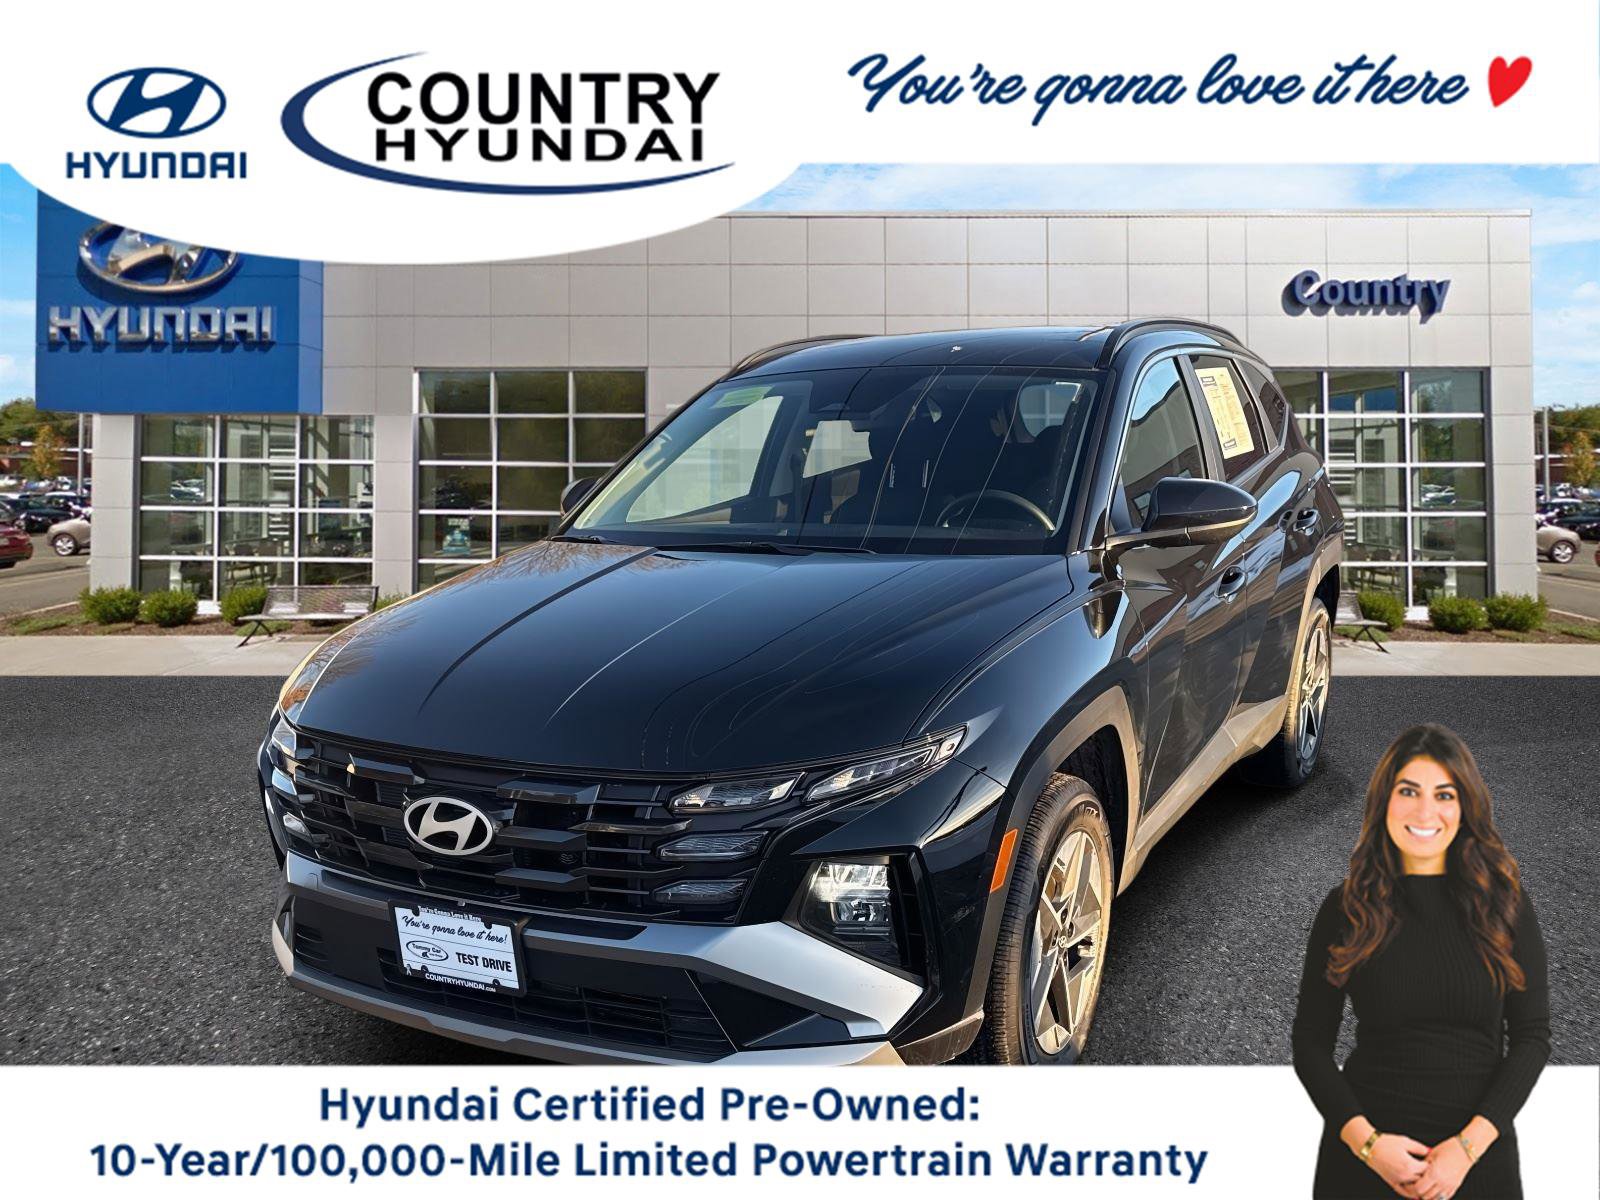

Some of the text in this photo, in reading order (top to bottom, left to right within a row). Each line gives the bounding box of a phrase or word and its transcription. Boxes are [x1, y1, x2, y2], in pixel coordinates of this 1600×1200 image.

[1281, 270, 1451, 323] Country
[48, 306, 273, 346] HYUNDAI
[402, 915, 431, 930] You're
[431, 924, 456, 935] gonna
[457, 926, 476, 939] love
[476, 929, 488, 940] it
[455, 952, 513, 973] TEST DRIVE
